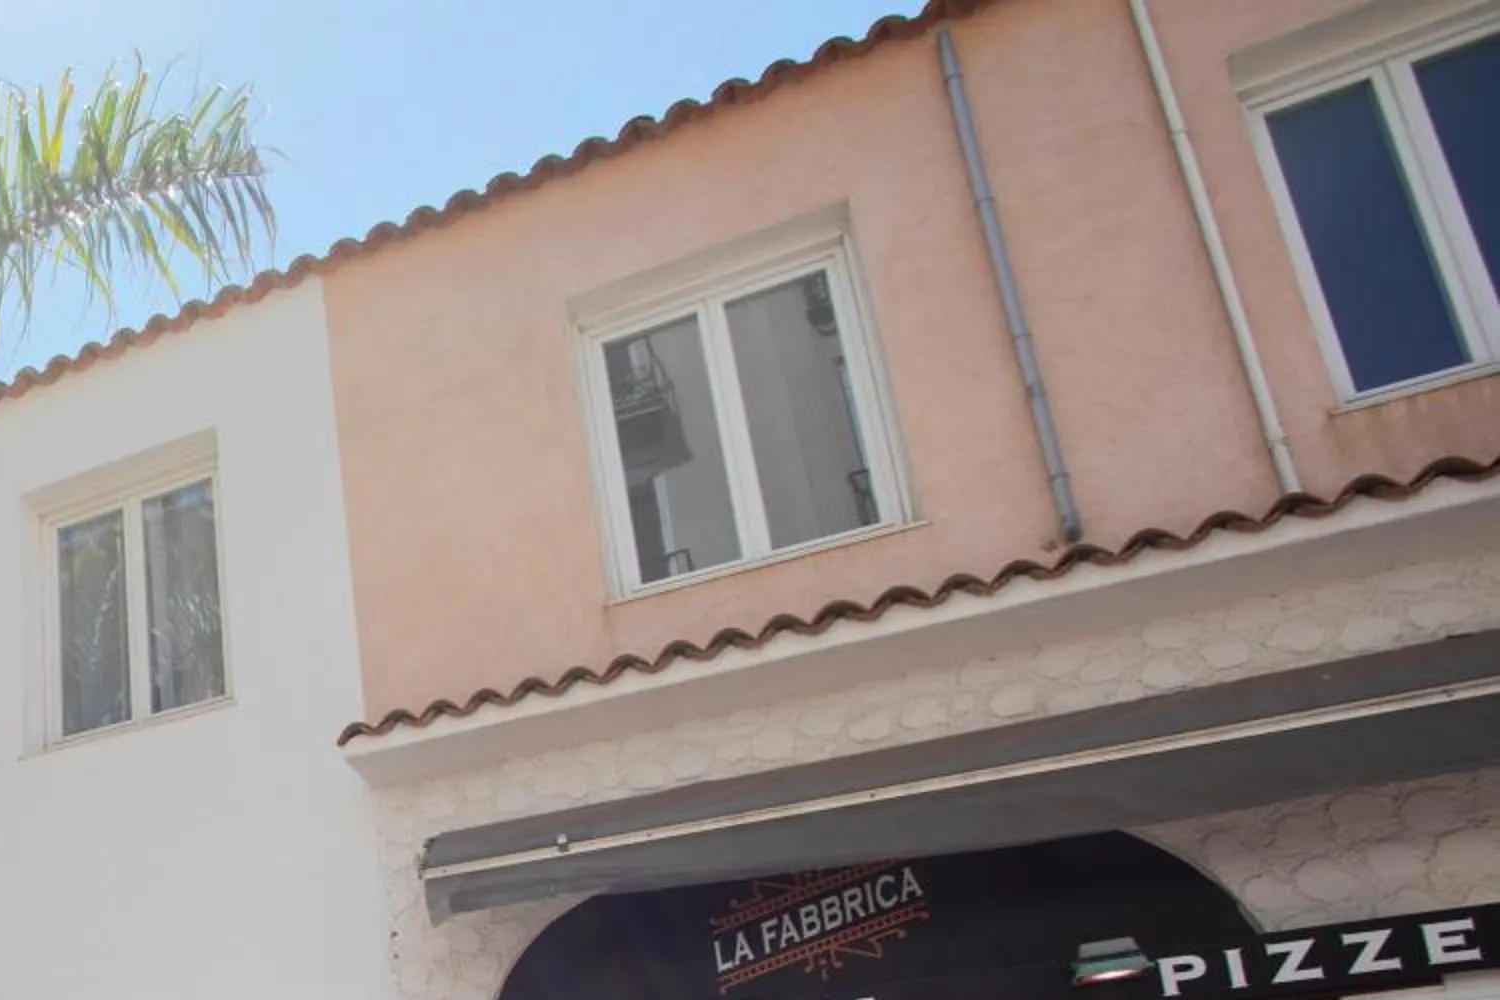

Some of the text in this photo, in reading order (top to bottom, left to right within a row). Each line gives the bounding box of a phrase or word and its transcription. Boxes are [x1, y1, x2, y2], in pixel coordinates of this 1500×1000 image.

[713, 866, 923, 974] LA FABBRICA
[1156, 916, 1483, 997] PIZZE
